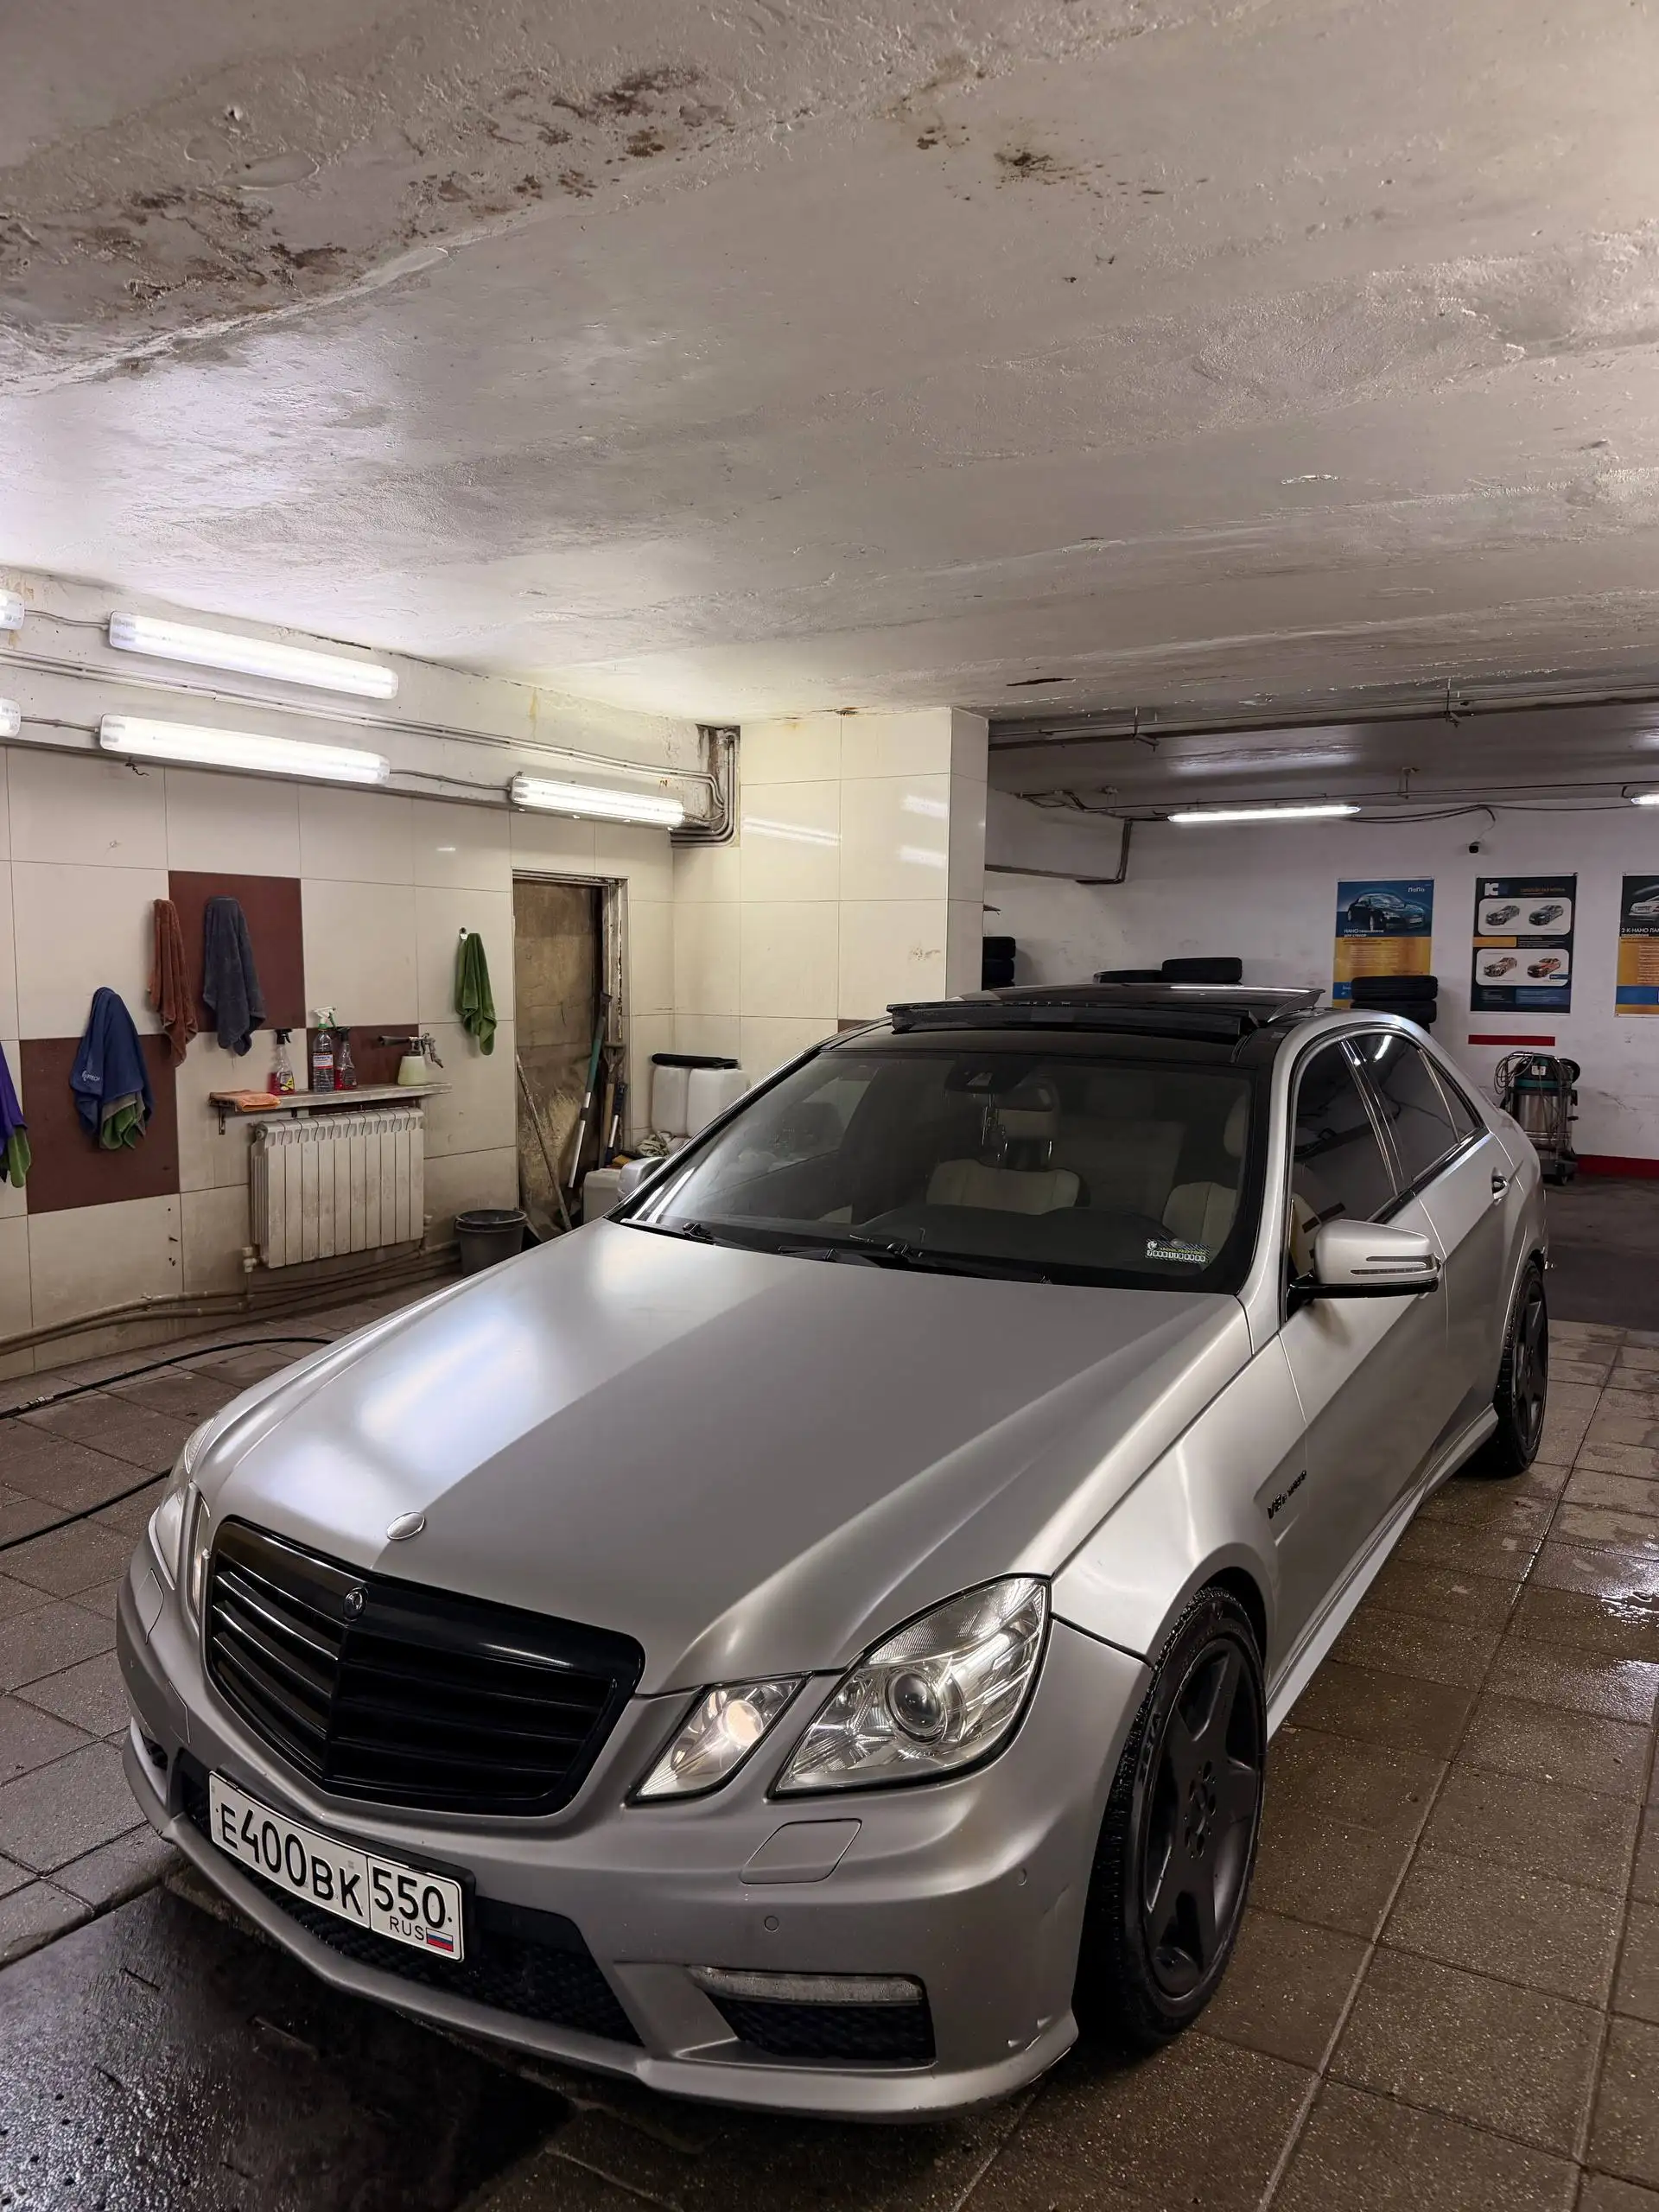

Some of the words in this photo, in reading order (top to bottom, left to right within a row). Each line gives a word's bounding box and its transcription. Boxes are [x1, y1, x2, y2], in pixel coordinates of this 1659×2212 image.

[220, 1802, 365, 1917] E400BK
[372, 1866, 447, 1929] 550
[389, 1915, 424, 1941] RUS
